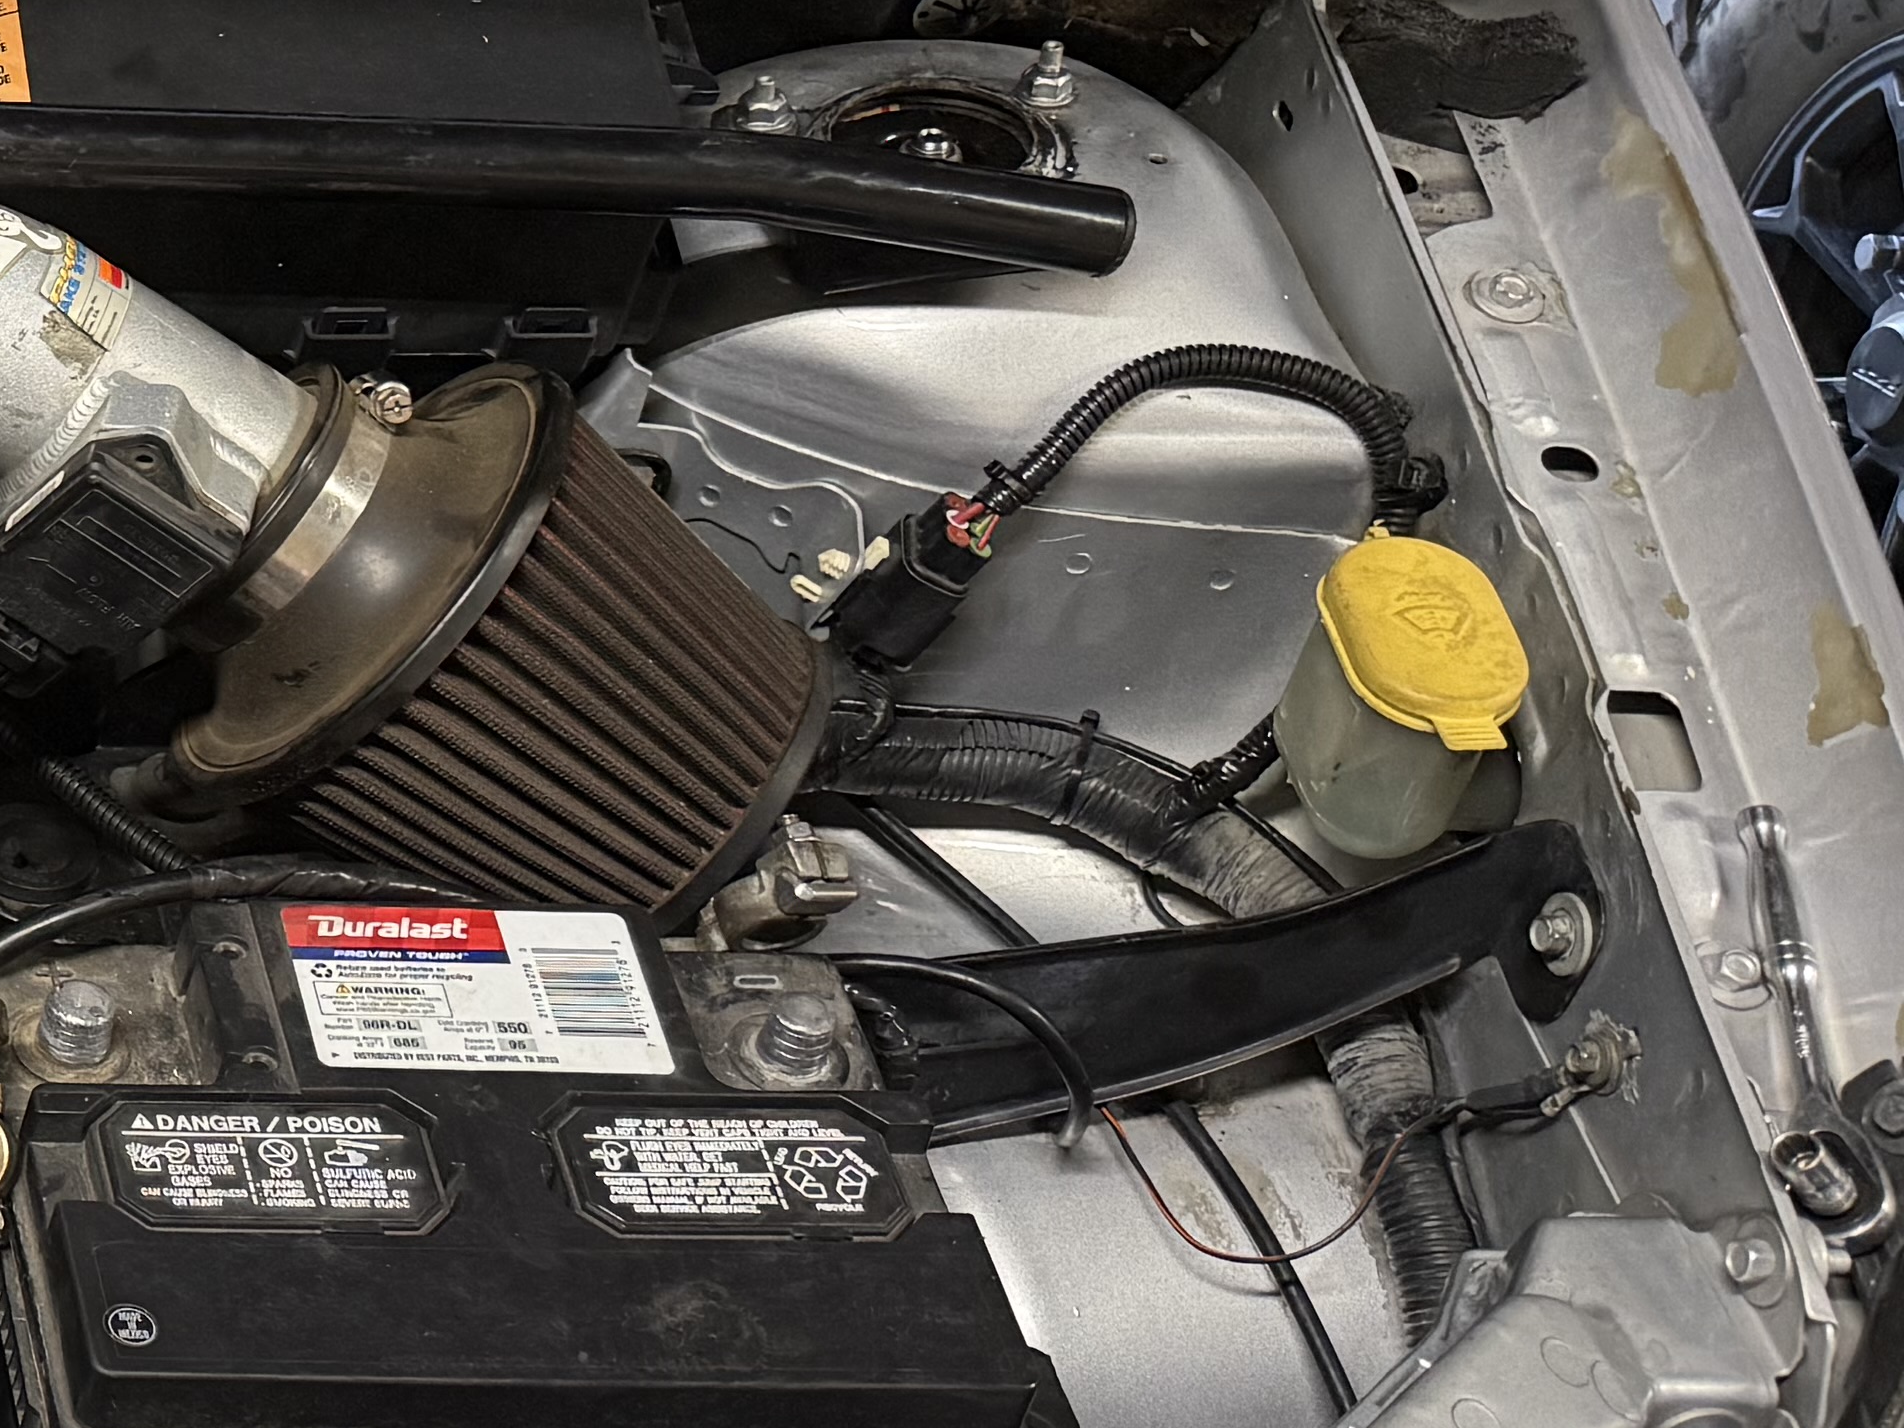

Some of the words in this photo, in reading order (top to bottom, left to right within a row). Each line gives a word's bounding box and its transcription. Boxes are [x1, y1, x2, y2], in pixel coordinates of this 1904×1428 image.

[308, 914, 468, 940] Duralast
[334, 950, 402, 959] PROVEN
[432, 973, 473, 981] recycling
[497, 1022, 528, 1033] 550
[156, 1114, 260, 1133] DANGER
[287, 1116, 382, 1133] POISON
[595, 1126, 612, 1136] DO
[193, 1143, 239, 1154] SHIELD
[167, 1164, 236, 1175] EXPLOSIVE
[269, 1167, 292, 1178] NO
[322, 1168, 383, 1179] SULFURIC
[387, 1169, 416, 1180] ACID
[171, 1175, 212, 1187] GASES
